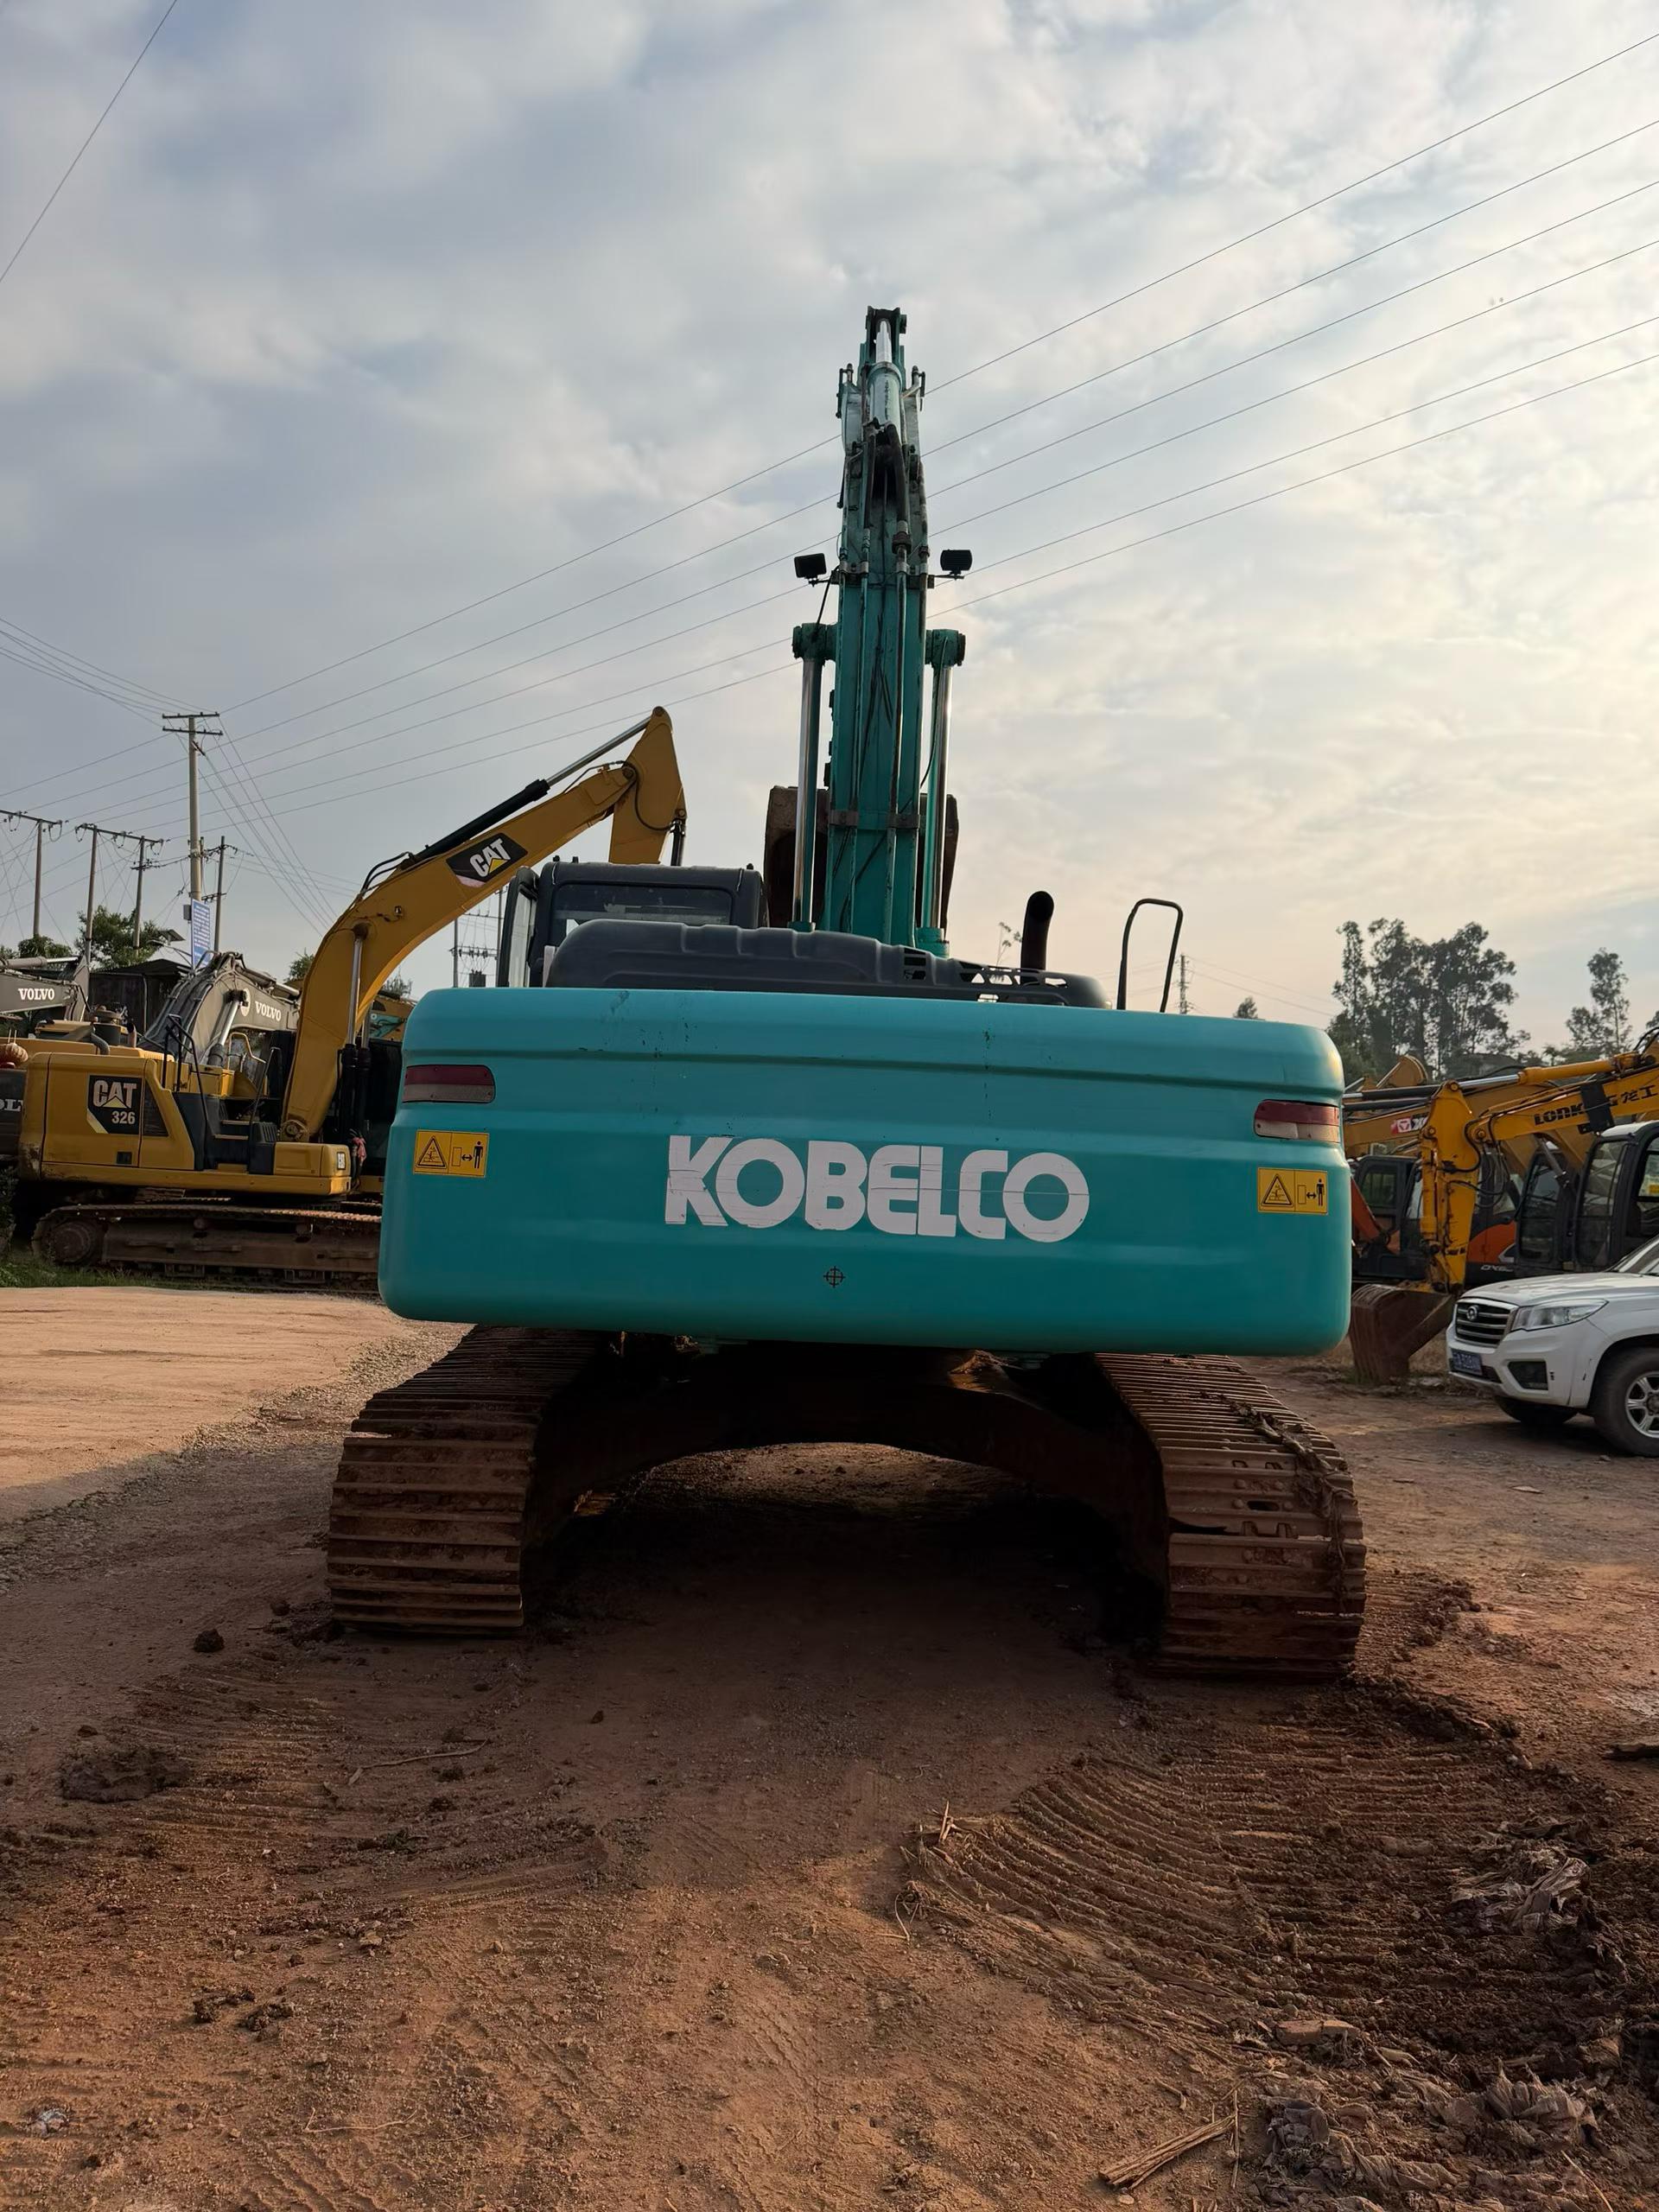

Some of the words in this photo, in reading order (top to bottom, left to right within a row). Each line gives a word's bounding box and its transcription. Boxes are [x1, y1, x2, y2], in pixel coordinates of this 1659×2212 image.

[469, 837, 512, 877] CAT
[18, 988, 55, 1001] VOLVO
[255, 1001, 282, 1021] VOLVO
[92, 1080, 137, 1109] CAT
[111, 1110, 136, 1125] 326
[1534, 1094, 1618, 1126] LONKG
[664, 1135, 1090, 1243] KOBELCO
